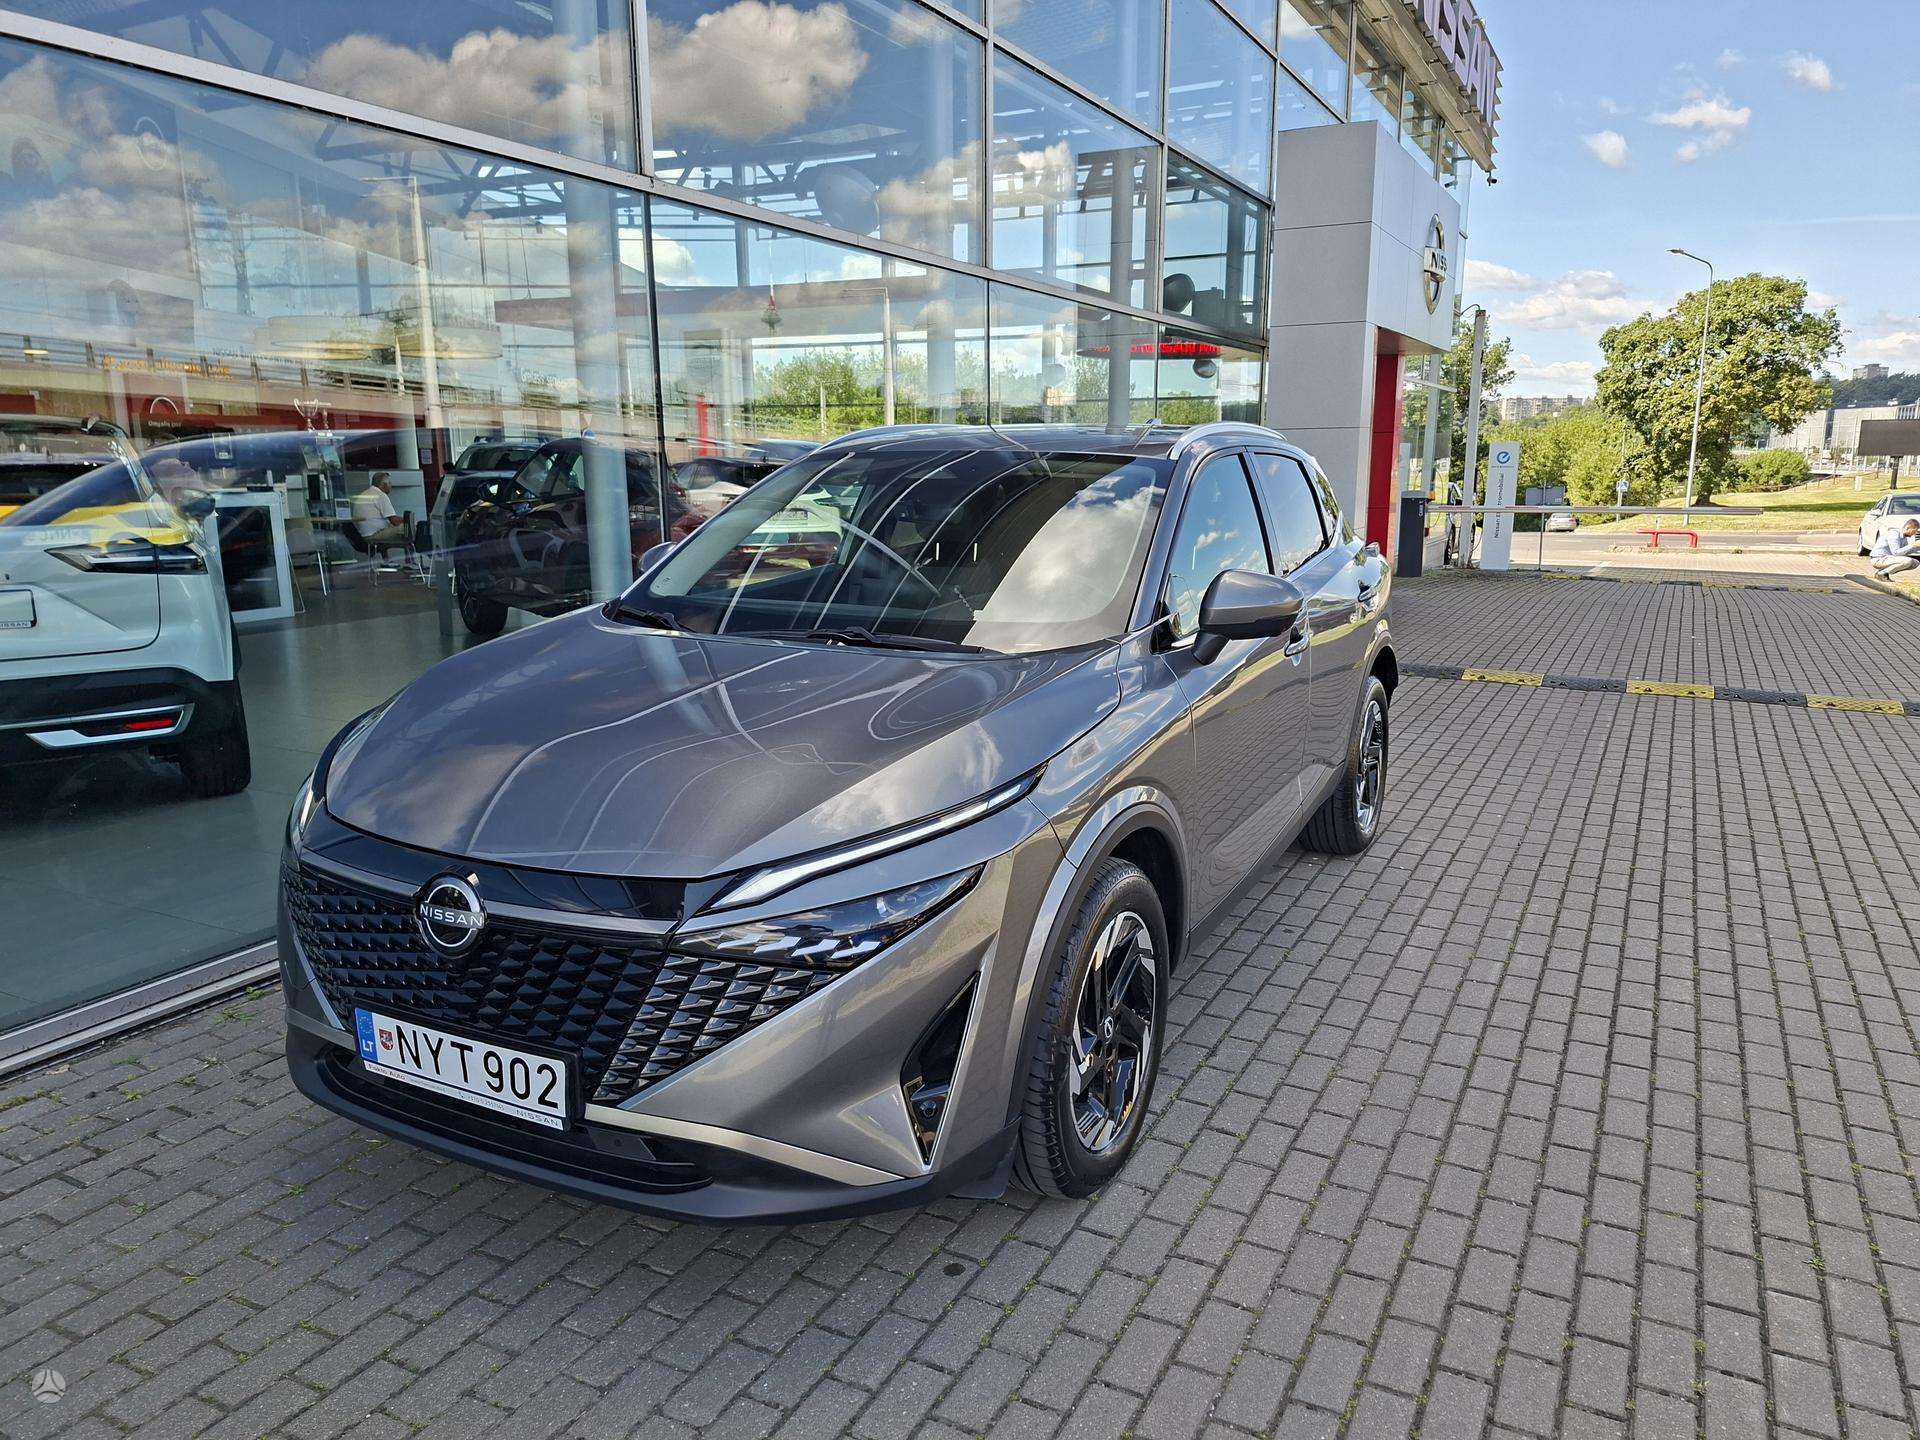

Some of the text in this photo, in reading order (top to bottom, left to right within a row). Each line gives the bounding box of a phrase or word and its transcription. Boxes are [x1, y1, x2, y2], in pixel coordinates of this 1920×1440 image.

[419, 903, 483, 926] NISSAN
[362, 1039, 374, 1053] LT
[515, 1109, 560, 1127] NISSAN
